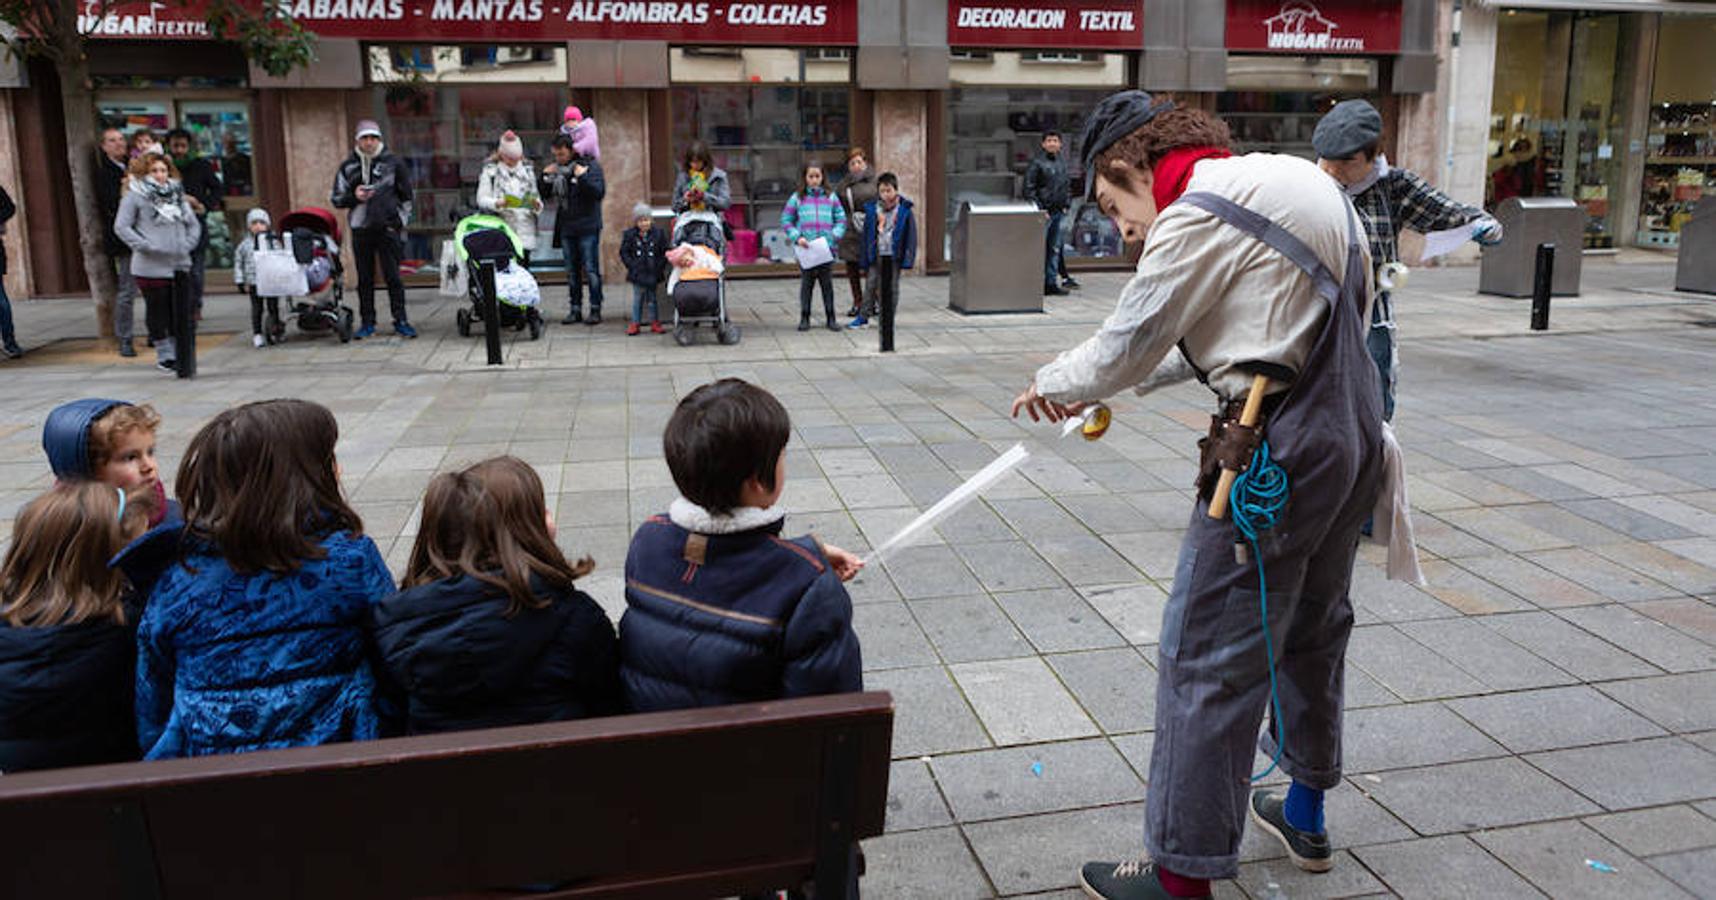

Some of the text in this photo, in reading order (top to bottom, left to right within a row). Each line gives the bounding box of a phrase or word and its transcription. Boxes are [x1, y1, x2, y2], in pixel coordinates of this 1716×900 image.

[276, 0, 404, 20] SABANAS
[430, 0, 543, 21] MANTAS
[566, 2, 709, 23] ALFOMBRAS
[727, 5, 827, 26] COLCHAS
[957, 7, 1136, 31] DECORACION TEXTIL
[1269, 31, 1330, 49] HOGAR
